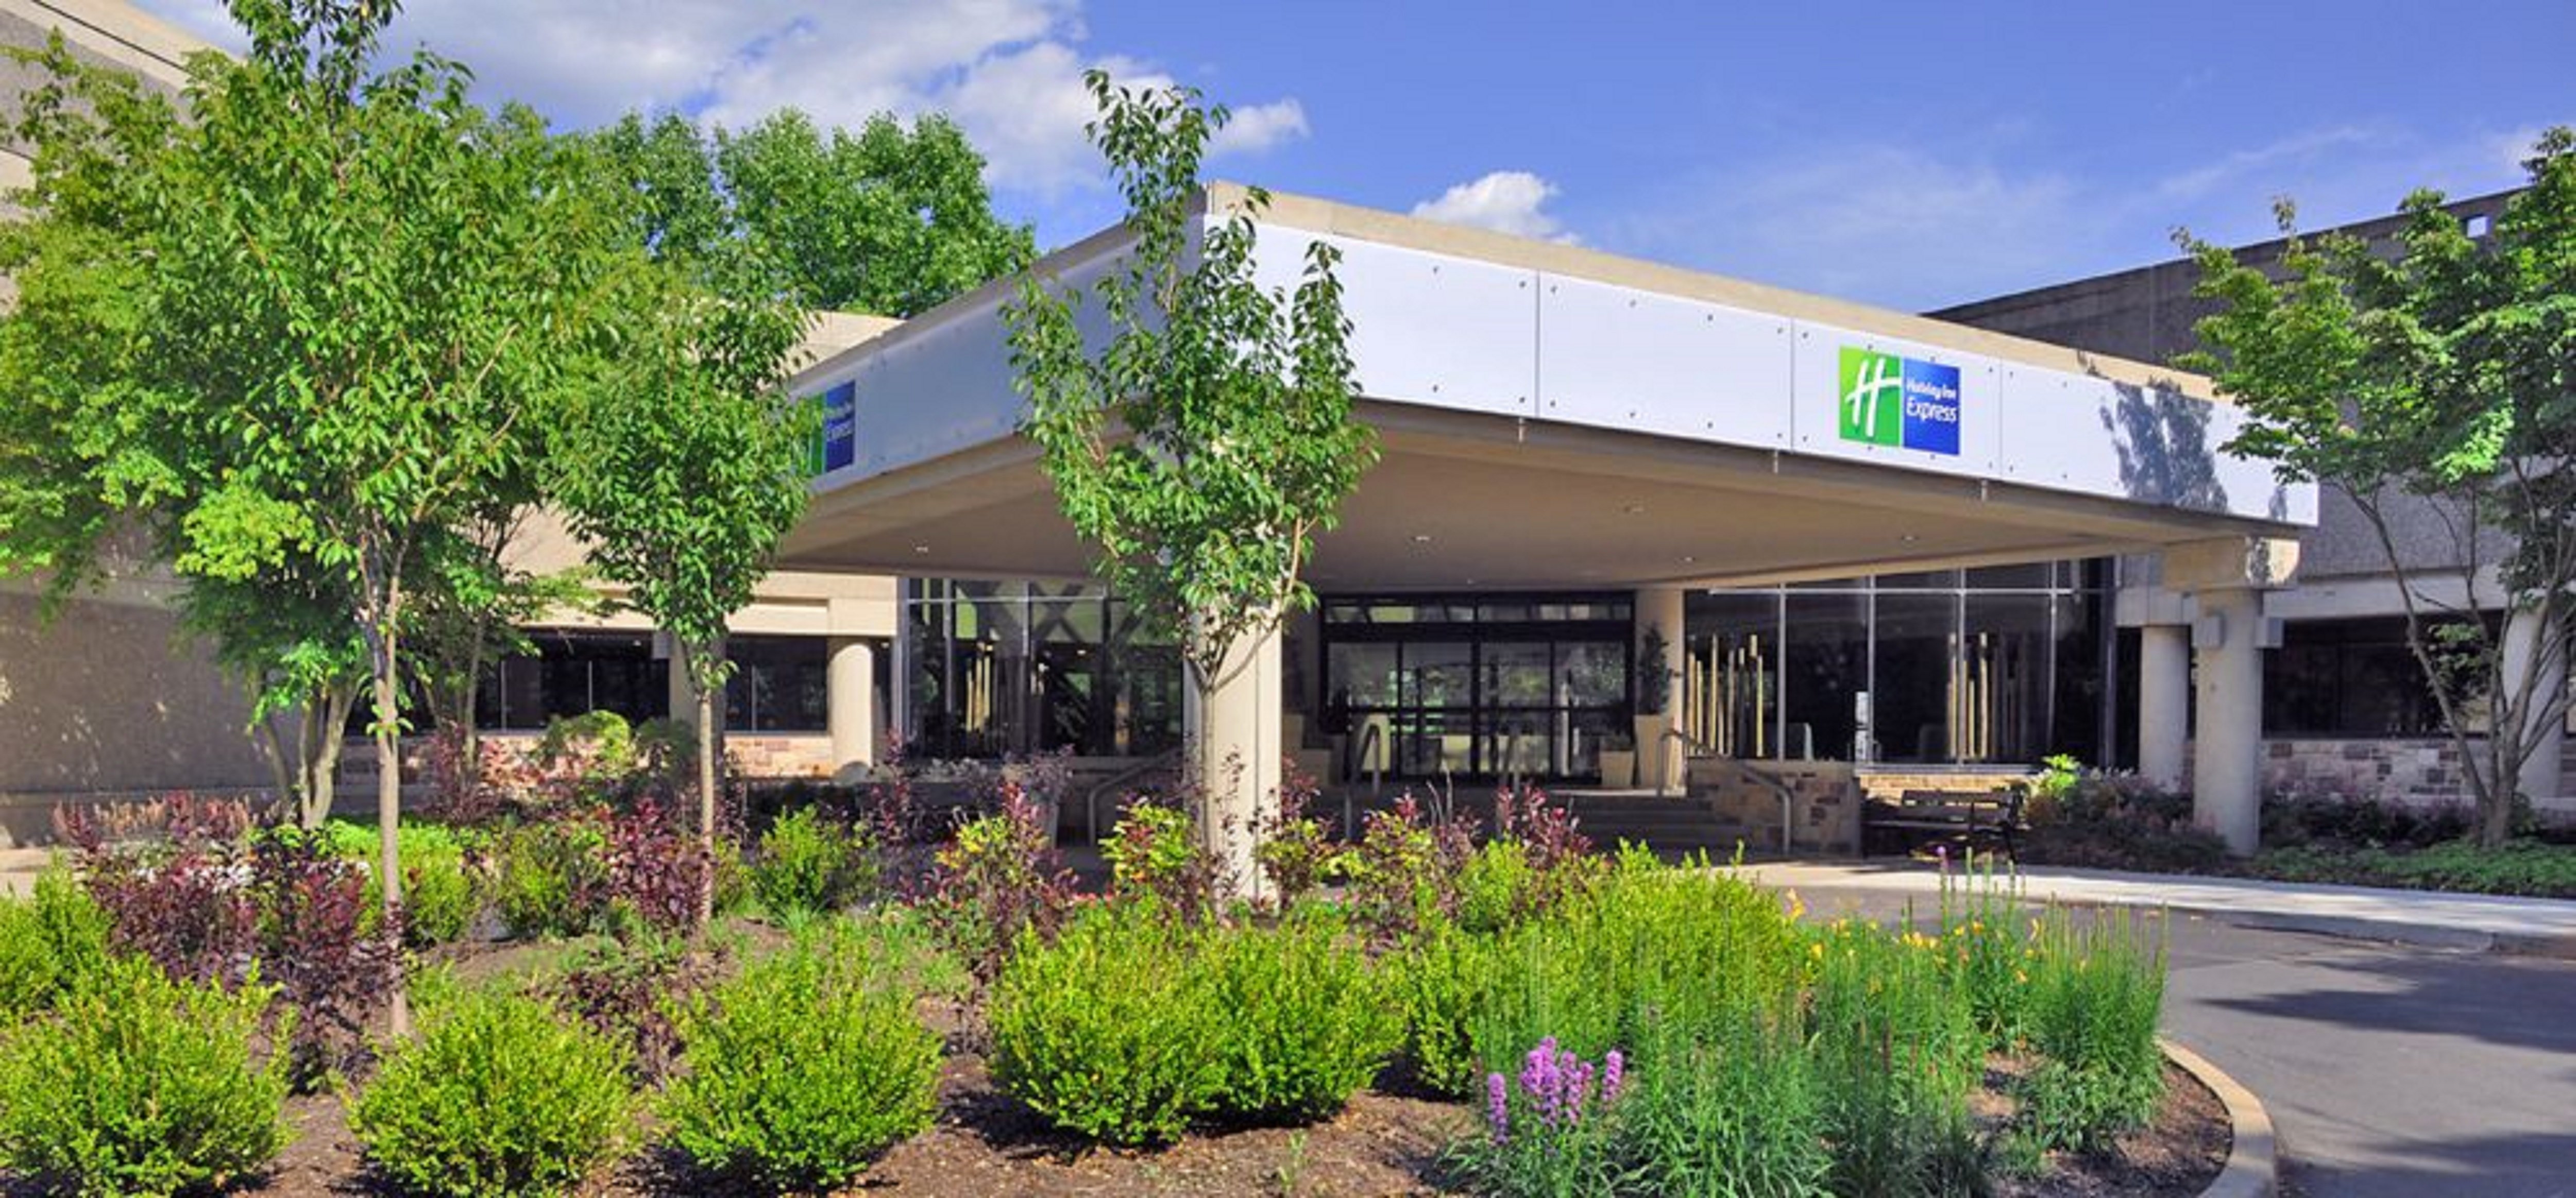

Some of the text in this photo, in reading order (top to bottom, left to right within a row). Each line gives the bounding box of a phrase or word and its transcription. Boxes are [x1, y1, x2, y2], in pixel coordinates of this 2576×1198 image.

[1907, 377, 1957, 400] Holiday Inn
[1907, 397, 1957, 423] Express
